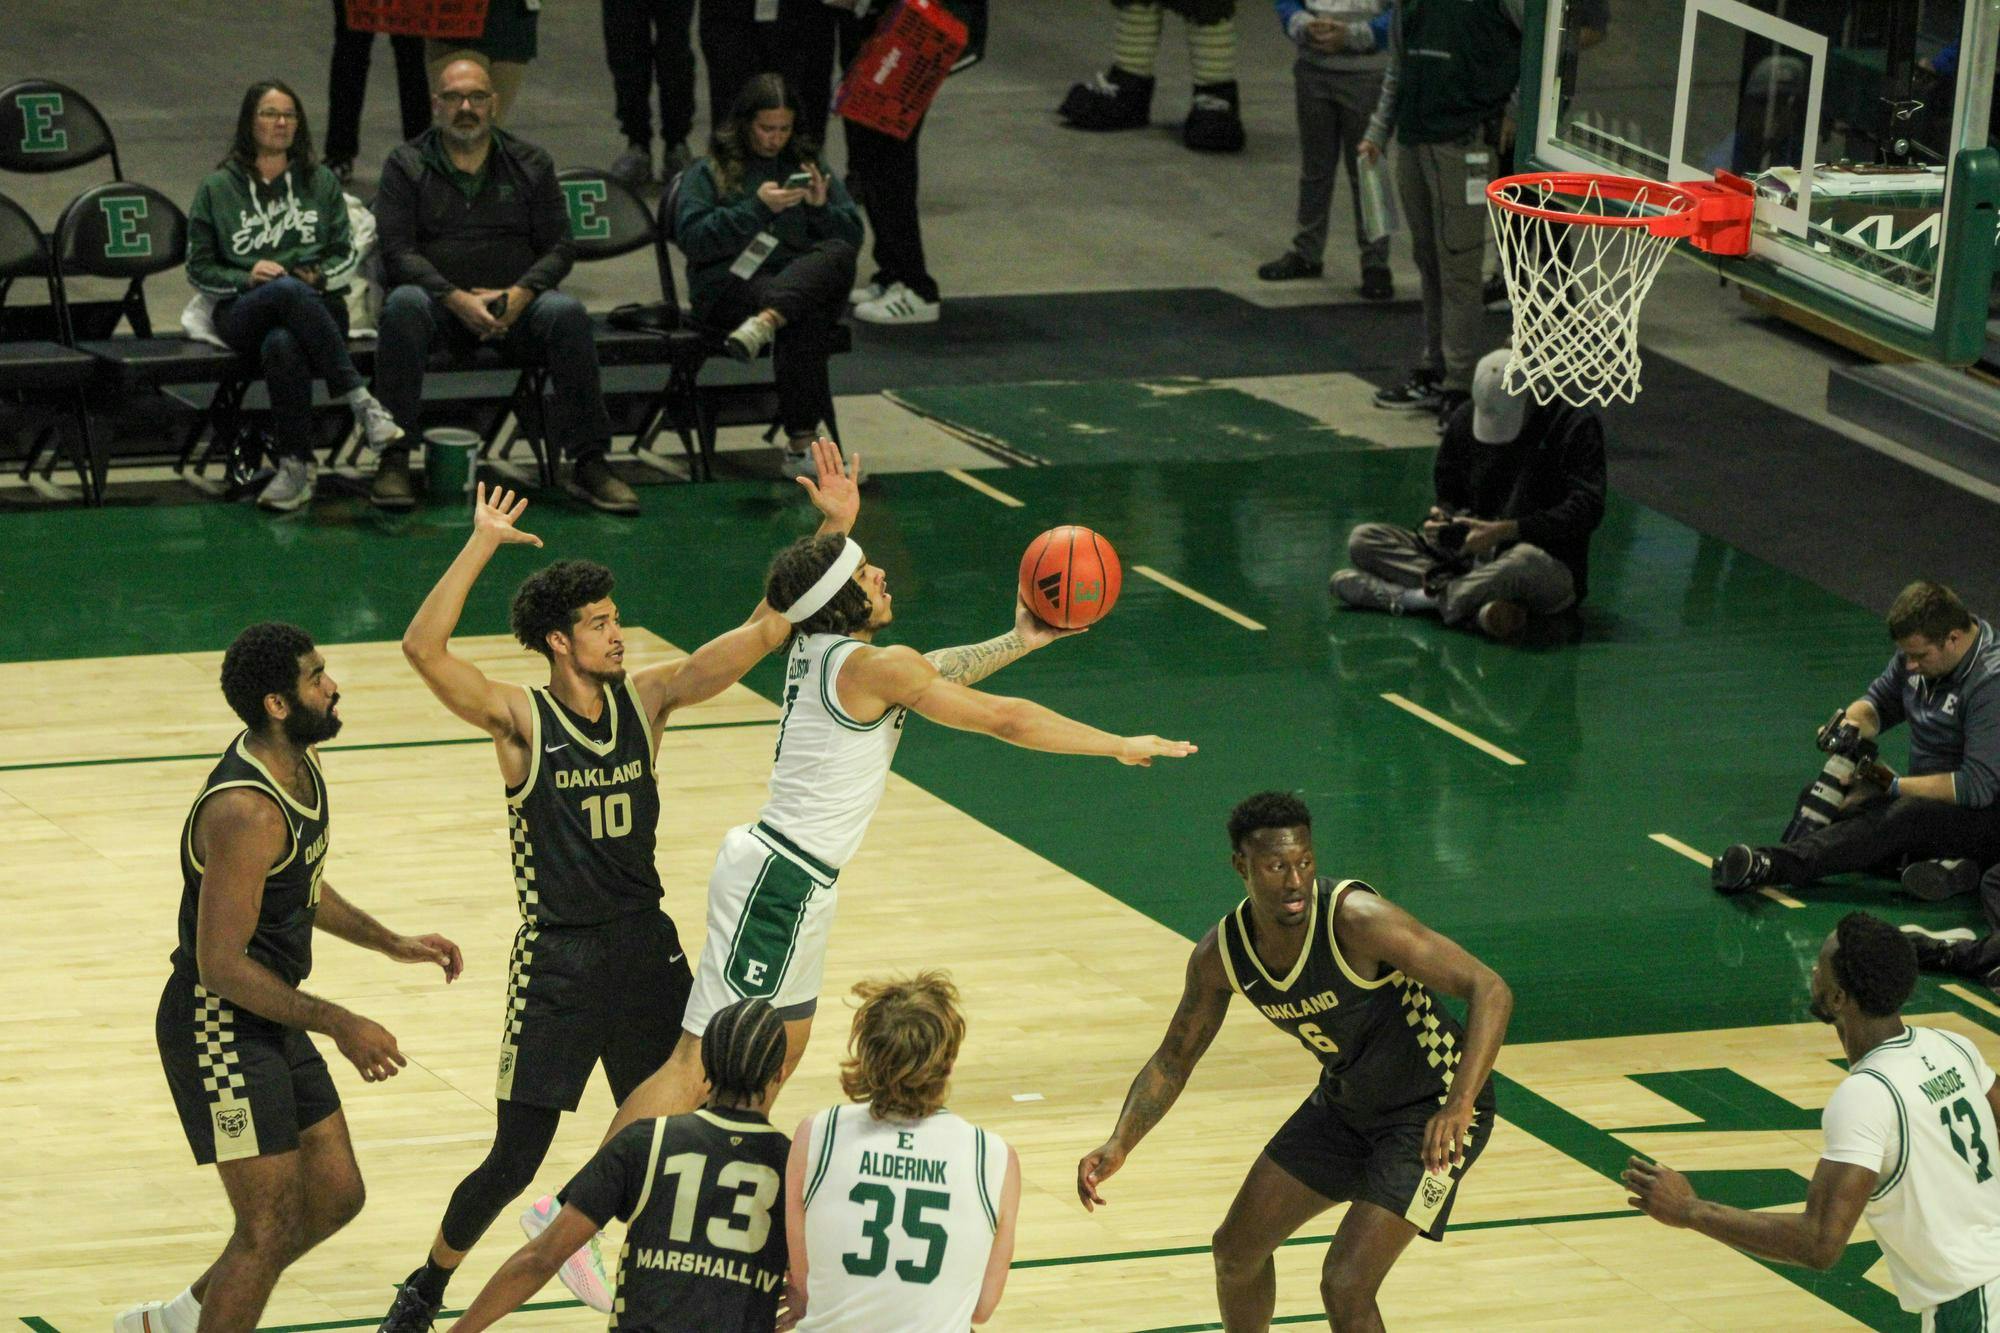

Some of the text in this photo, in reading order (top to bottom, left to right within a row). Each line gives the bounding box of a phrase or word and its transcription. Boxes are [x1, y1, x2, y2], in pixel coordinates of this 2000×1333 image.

[16, 93, 68, 152] E
[100, 196, 152, 257] E
[558, 180, 610, 240] E
[1941, 692, 1959, 717] E
[555, 759, 643, 789] OAKLAND
[581, 792, 633, 840] 10
[743, 958, 768, 987] E
[1261, 990, 1340, 1020] OAKLAND
[1298, 1022, 1339, 1053] 6
[1918, 1066, 1966, 1105] NWABUDE
[896, 1131, 915, 1151] E
[858, 1150, 948, 1186] ALDERINK
[663, 1152, 781, 1254] 13
[842, 1181, 951, 1285] 35
[636, 1248, 780, 1294] MARSHALL IV
